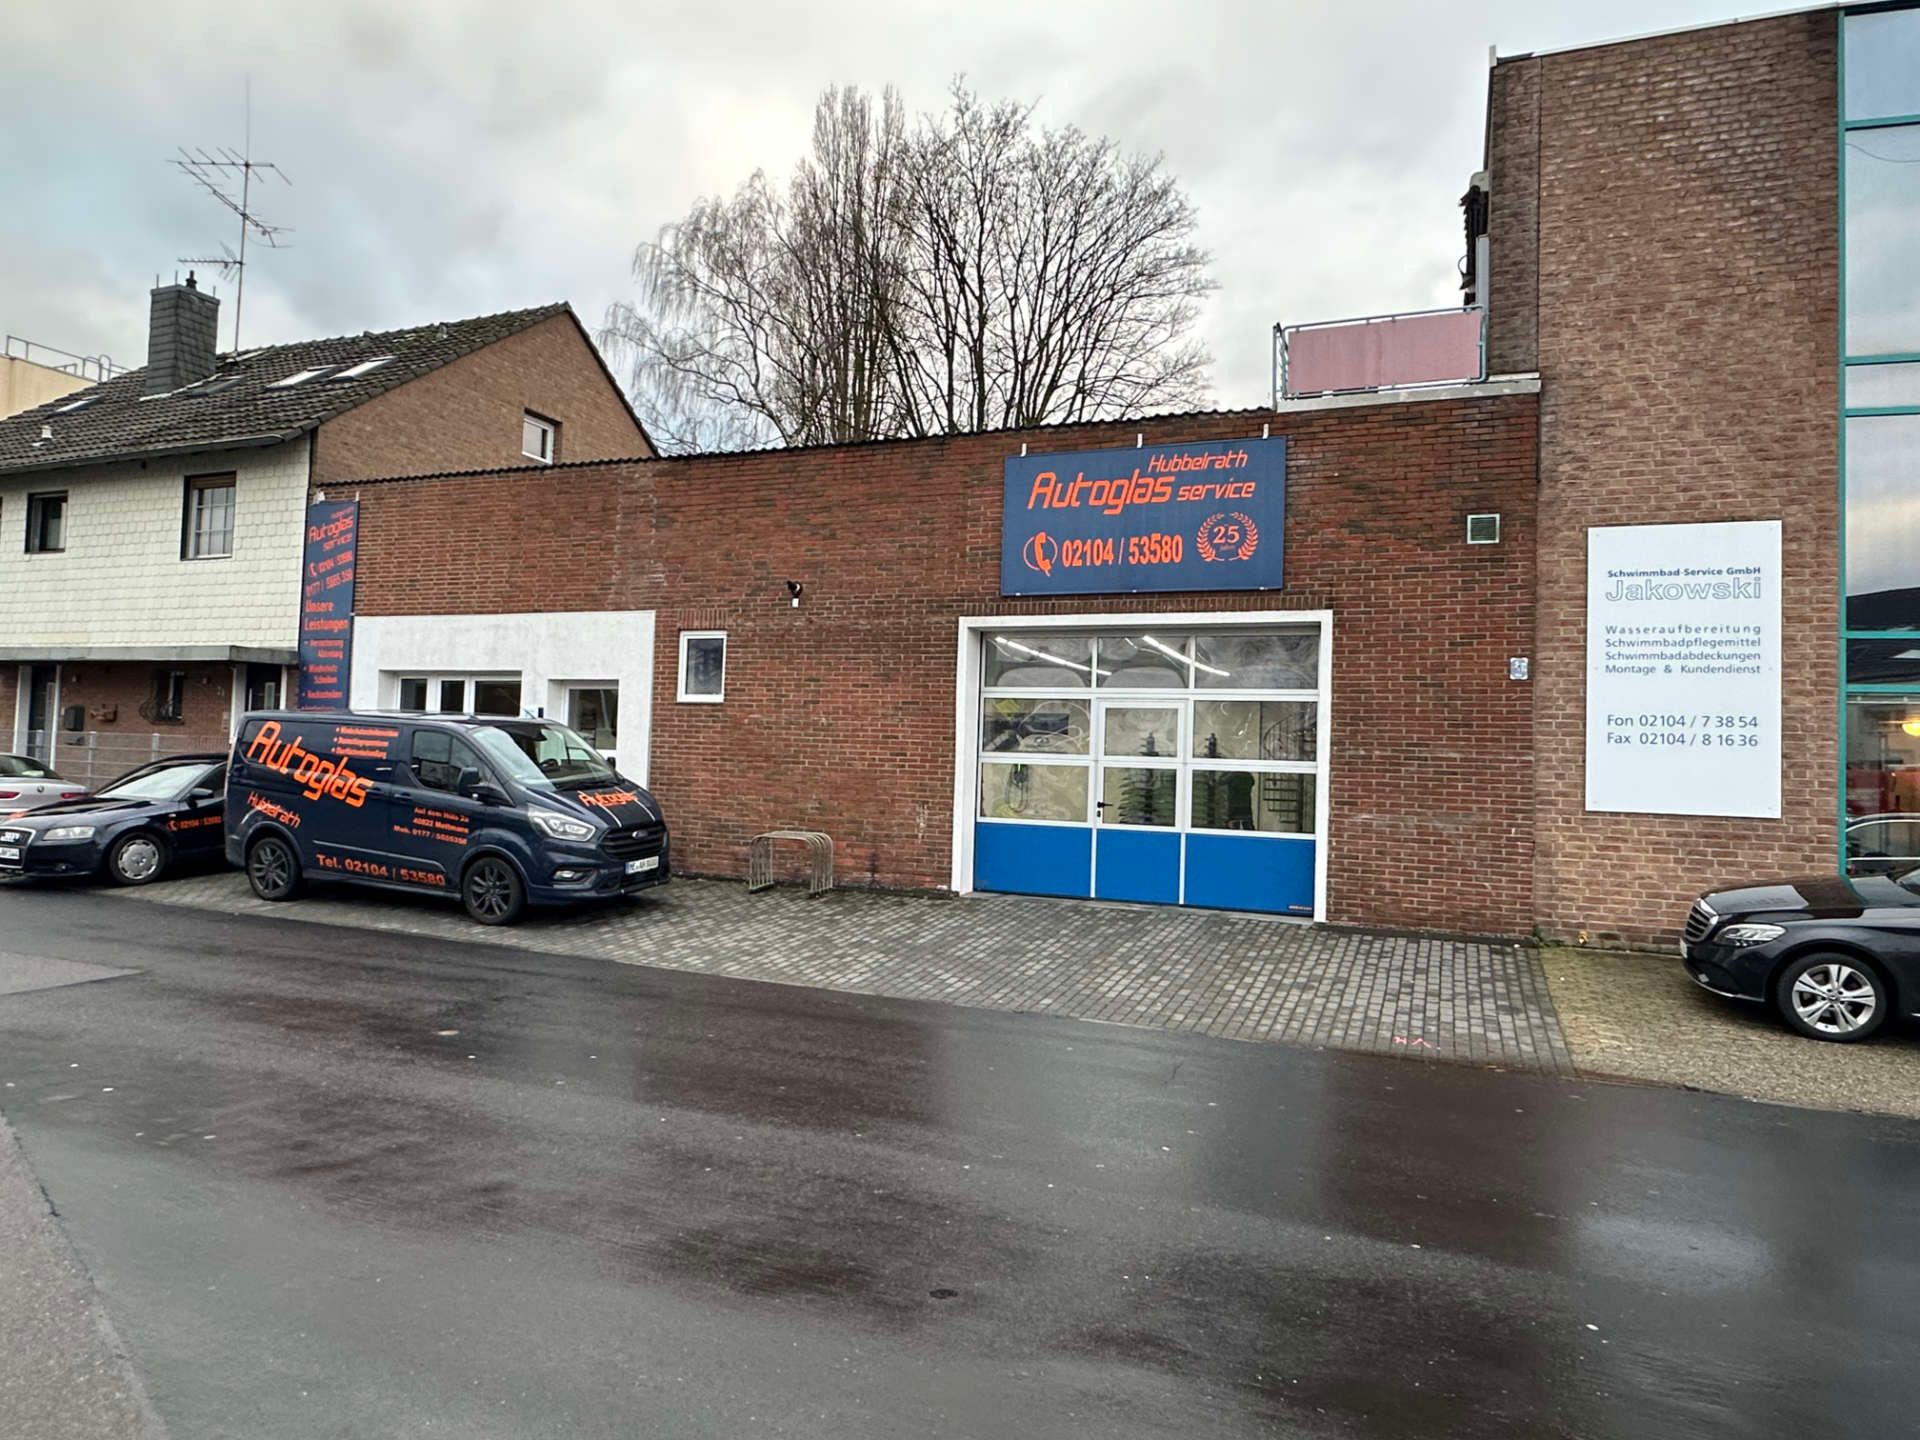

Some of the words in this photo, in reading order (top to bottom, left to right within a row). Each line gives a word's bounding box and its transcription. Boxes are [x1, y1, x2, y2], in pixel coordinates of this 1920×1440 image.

[1148, 449, 1248, 473] Hubbelrath
[1027, 469, 1175, 515] Autoglas
[1177, 478, 1256, 501] service
[308, 516, 354, 544] Autoglas
[1213, 525, 1240, 545] 25
[1061, 538, 1114, 568] 02104
[1118, 537, 1125, 566] /
[1128, 533, 1183, 565] 53580
[1607, 568, 1680, 578] Schwimmbad
[1684, 567, 1723, 577] Service
[1726, 566, 1761, 576] GmbH
[1604, 577, 1761, 601] Jakowski
[304, 617, 348, 633] Leistungen
[1605, 624, 1761, 636] Wasseraufbereitung
[1605, 637, 1761, 649] Schwimmbadpflegemittel
[1605, 650, 1761, 662] Schwimmbadabdeckungen
[1605, 664, 1656, 675] Montage
[1664, 664, 1673, 674] &
[1680, 664, 1761, 674] Kundendienst
[1607, 714, 1633, 727] Fon
[1639, 714, 1686, 727] 02104
[1690, 715, 1696, 728] /
[1607, 732, 1631, 745] Fax
[1639, 732, 1686, 745] 02104
[1690, 733, 1696, 746] /
[247, 720, 375, 809] Autoglas
[316, 854, 342, 871] Tel.
[344, 857, 389, 878] 02104
[400, 866, 446, 887] 53580
